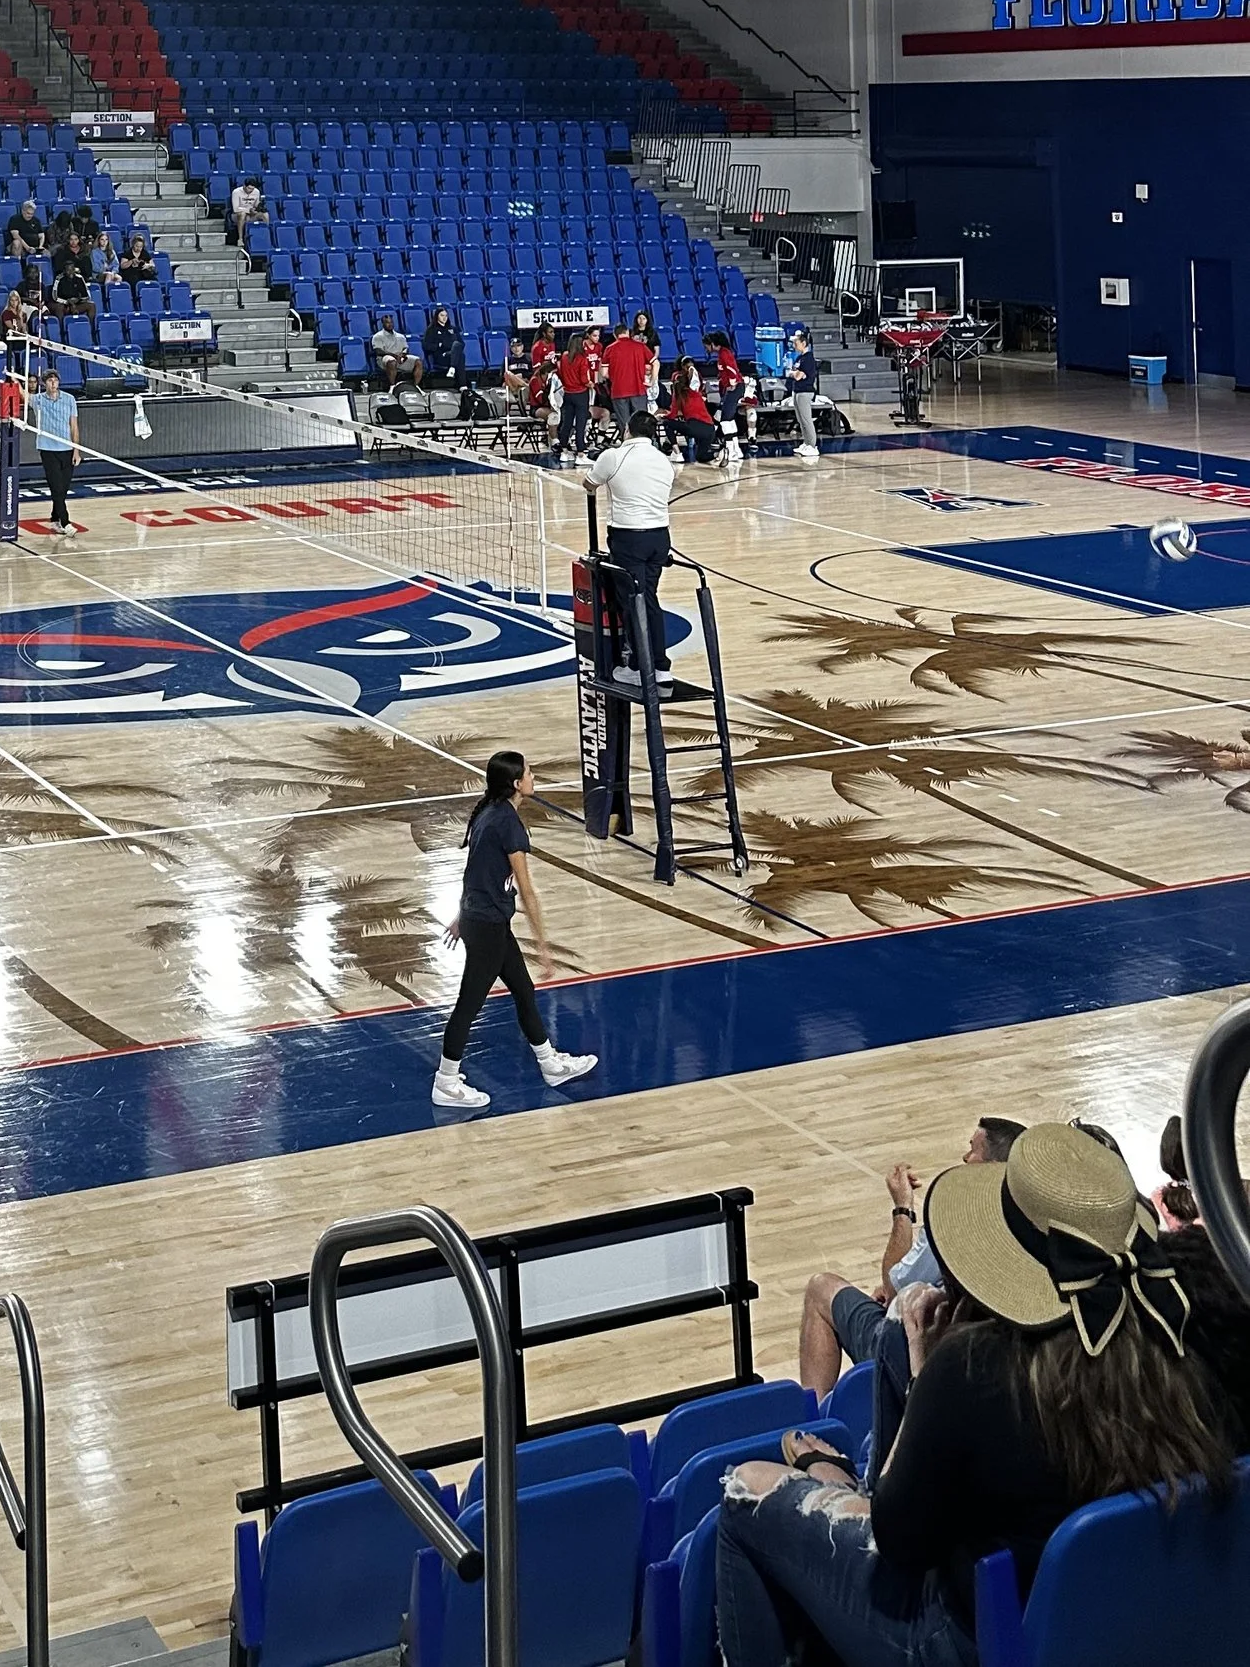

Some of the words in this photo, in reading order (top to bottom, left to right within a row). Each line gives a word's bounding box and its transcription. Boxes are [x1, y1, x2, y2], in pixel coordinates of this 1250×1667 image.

[93, 113, 133, 123] SECTION
[93, 126, 102, 138] D
[126, 125, 134, 137] E
[533, 311, 583, 323] SECTION
[586, 310, 594, 322] E
[170, 321, 201, 329] SECTION
[591, 361, 596, 370] 3
[119, 491, 462, 528] COURT
[578, 654, 600, 781] ATLANTIC
[596, 691, 607, 750] FLORIDA
